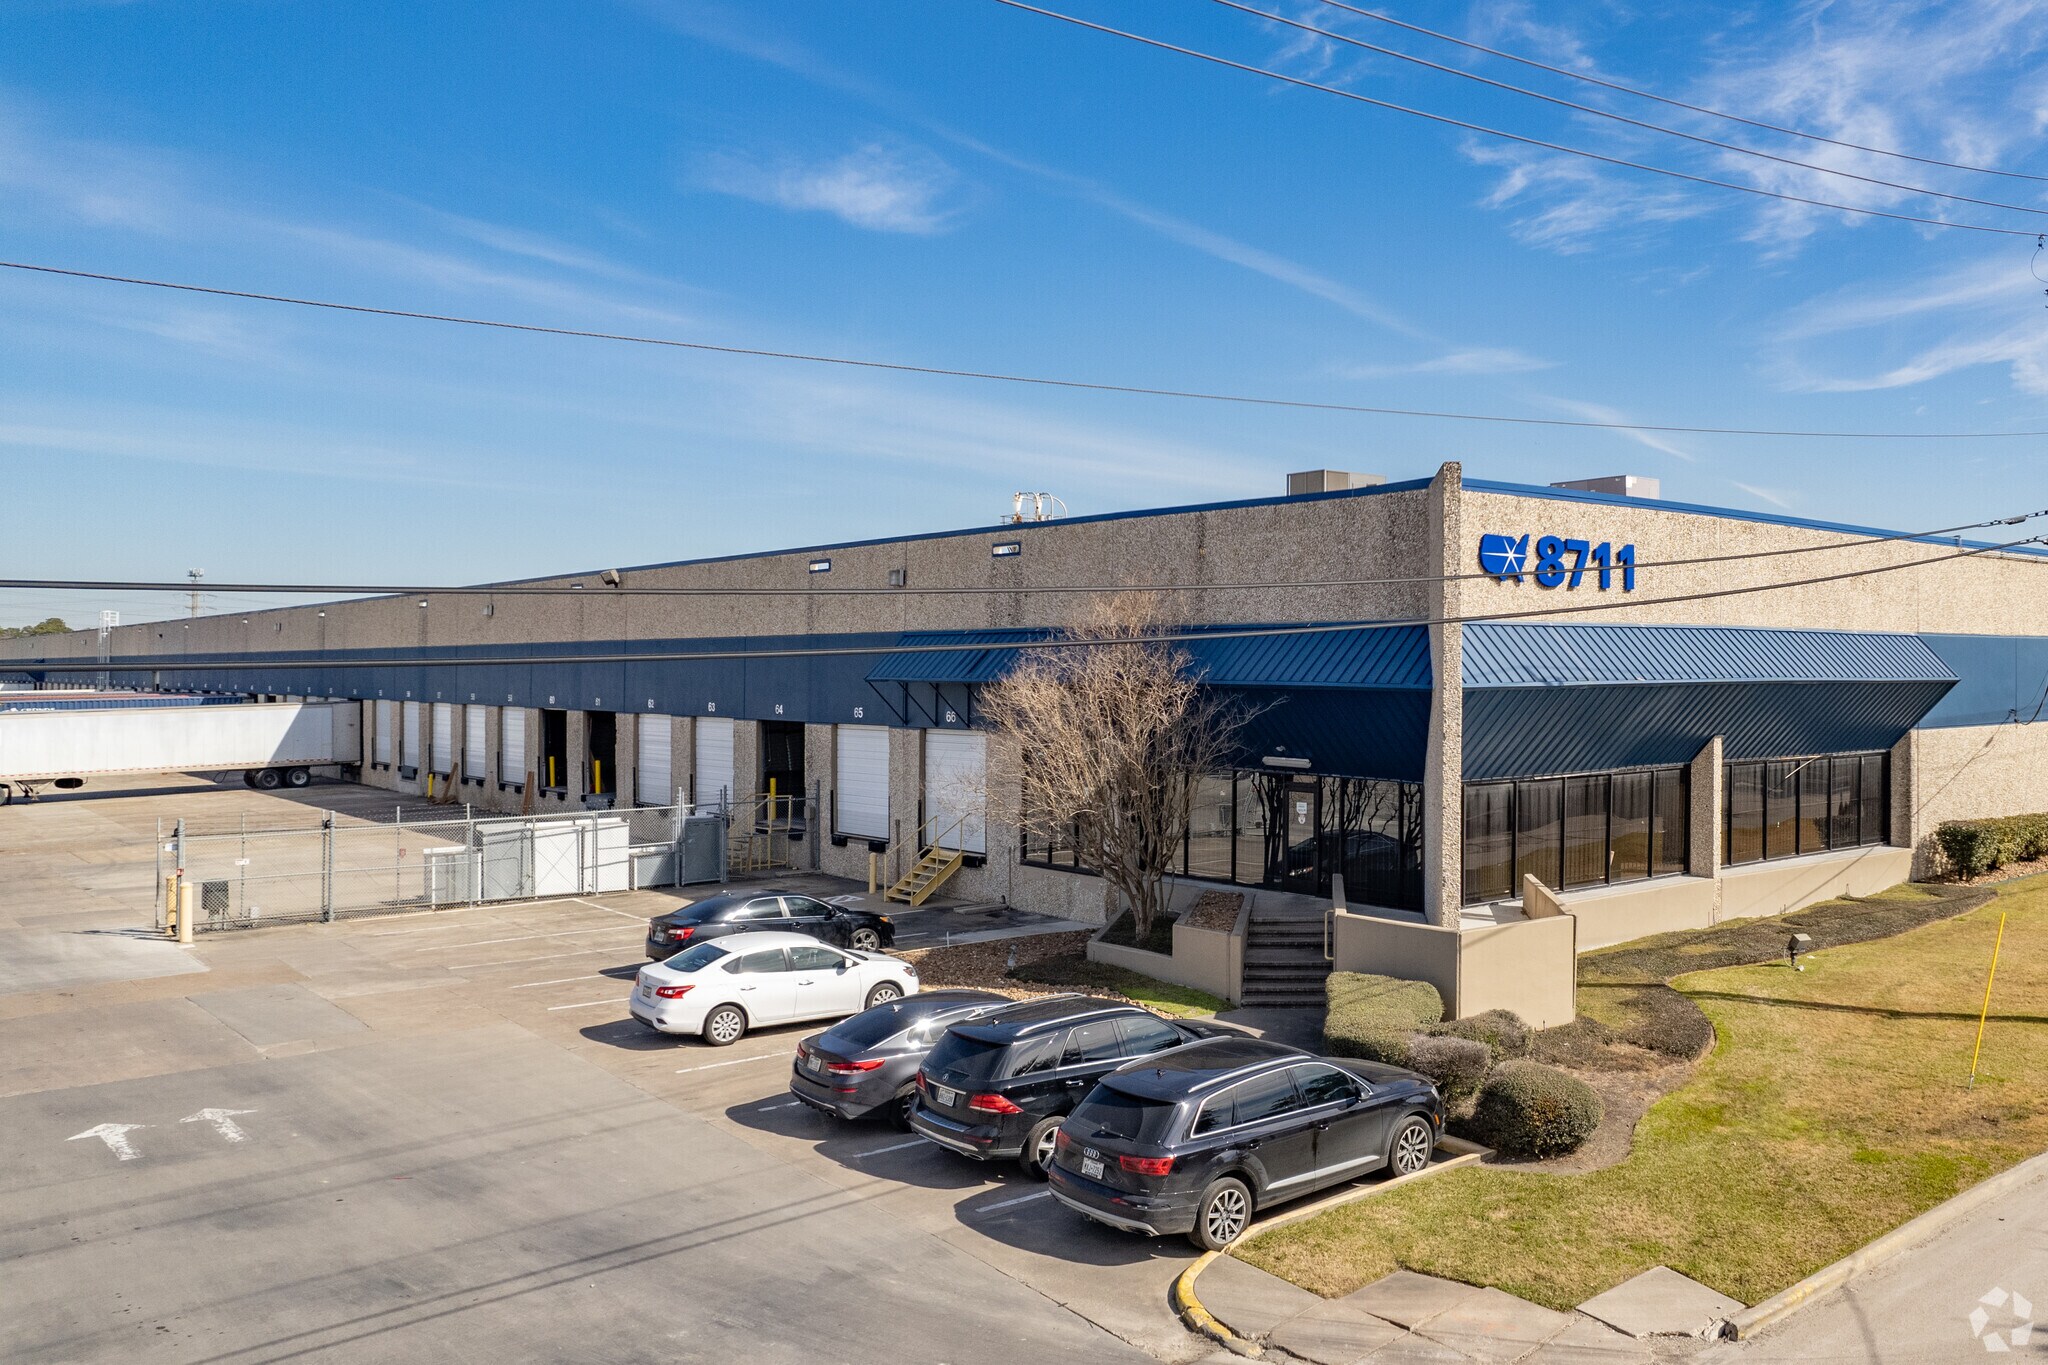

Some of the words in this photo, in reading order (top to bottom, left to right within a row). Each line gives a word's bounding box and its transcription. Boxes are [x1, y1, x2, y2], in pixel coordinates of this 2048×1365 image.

[1536, 535, 1635, 592] 8711
[708, 702, 716, 712] 63
[775, 704, 784, 715] 64
[854, 707, 864, 718] 65
[946, 710, 957, 722] 66
